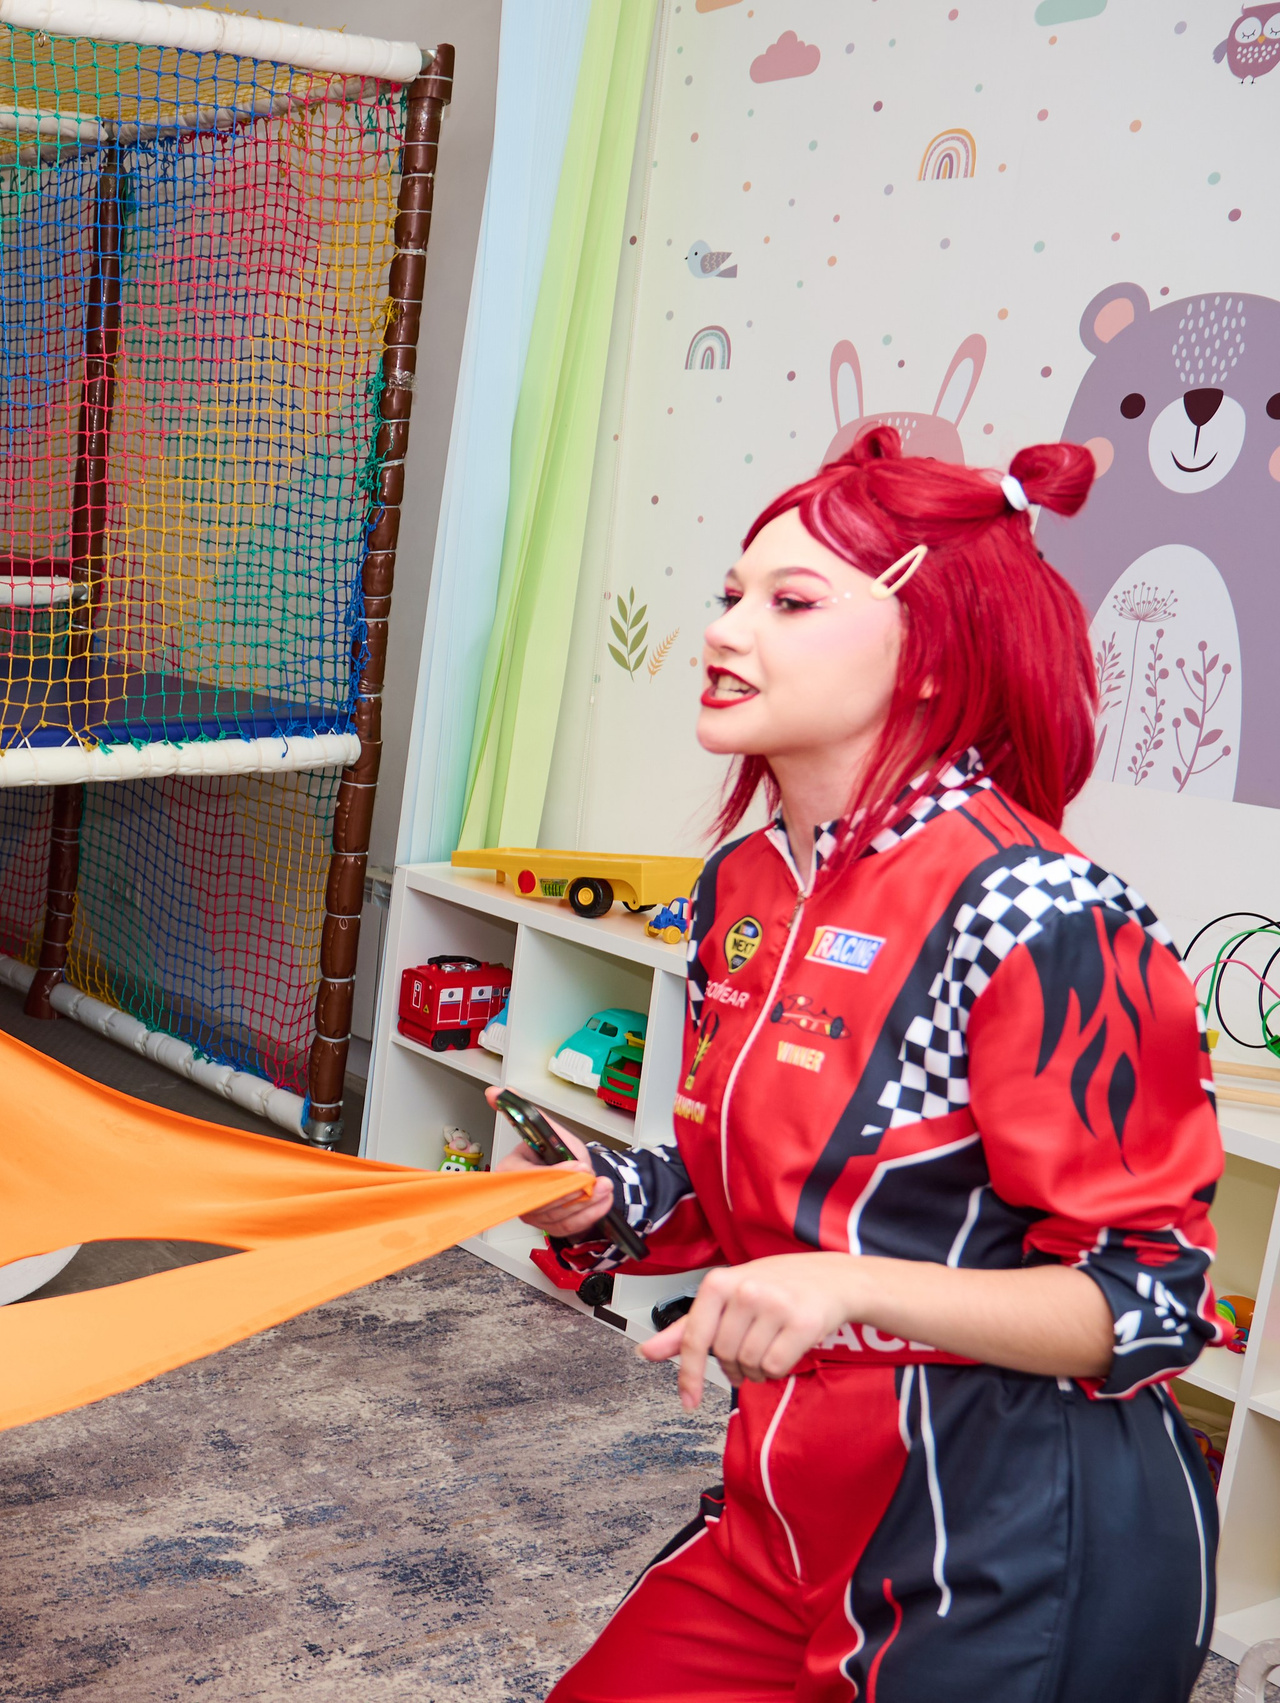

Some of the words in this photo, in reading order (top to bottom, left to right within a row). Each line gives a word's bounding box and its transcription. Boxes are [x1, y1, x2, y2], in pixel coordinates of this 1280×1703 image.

[732, 938, 756, 955] NEXT
[814, 931, 880, 967] RACING
[776, 1040, 826, 1073] WINNER
